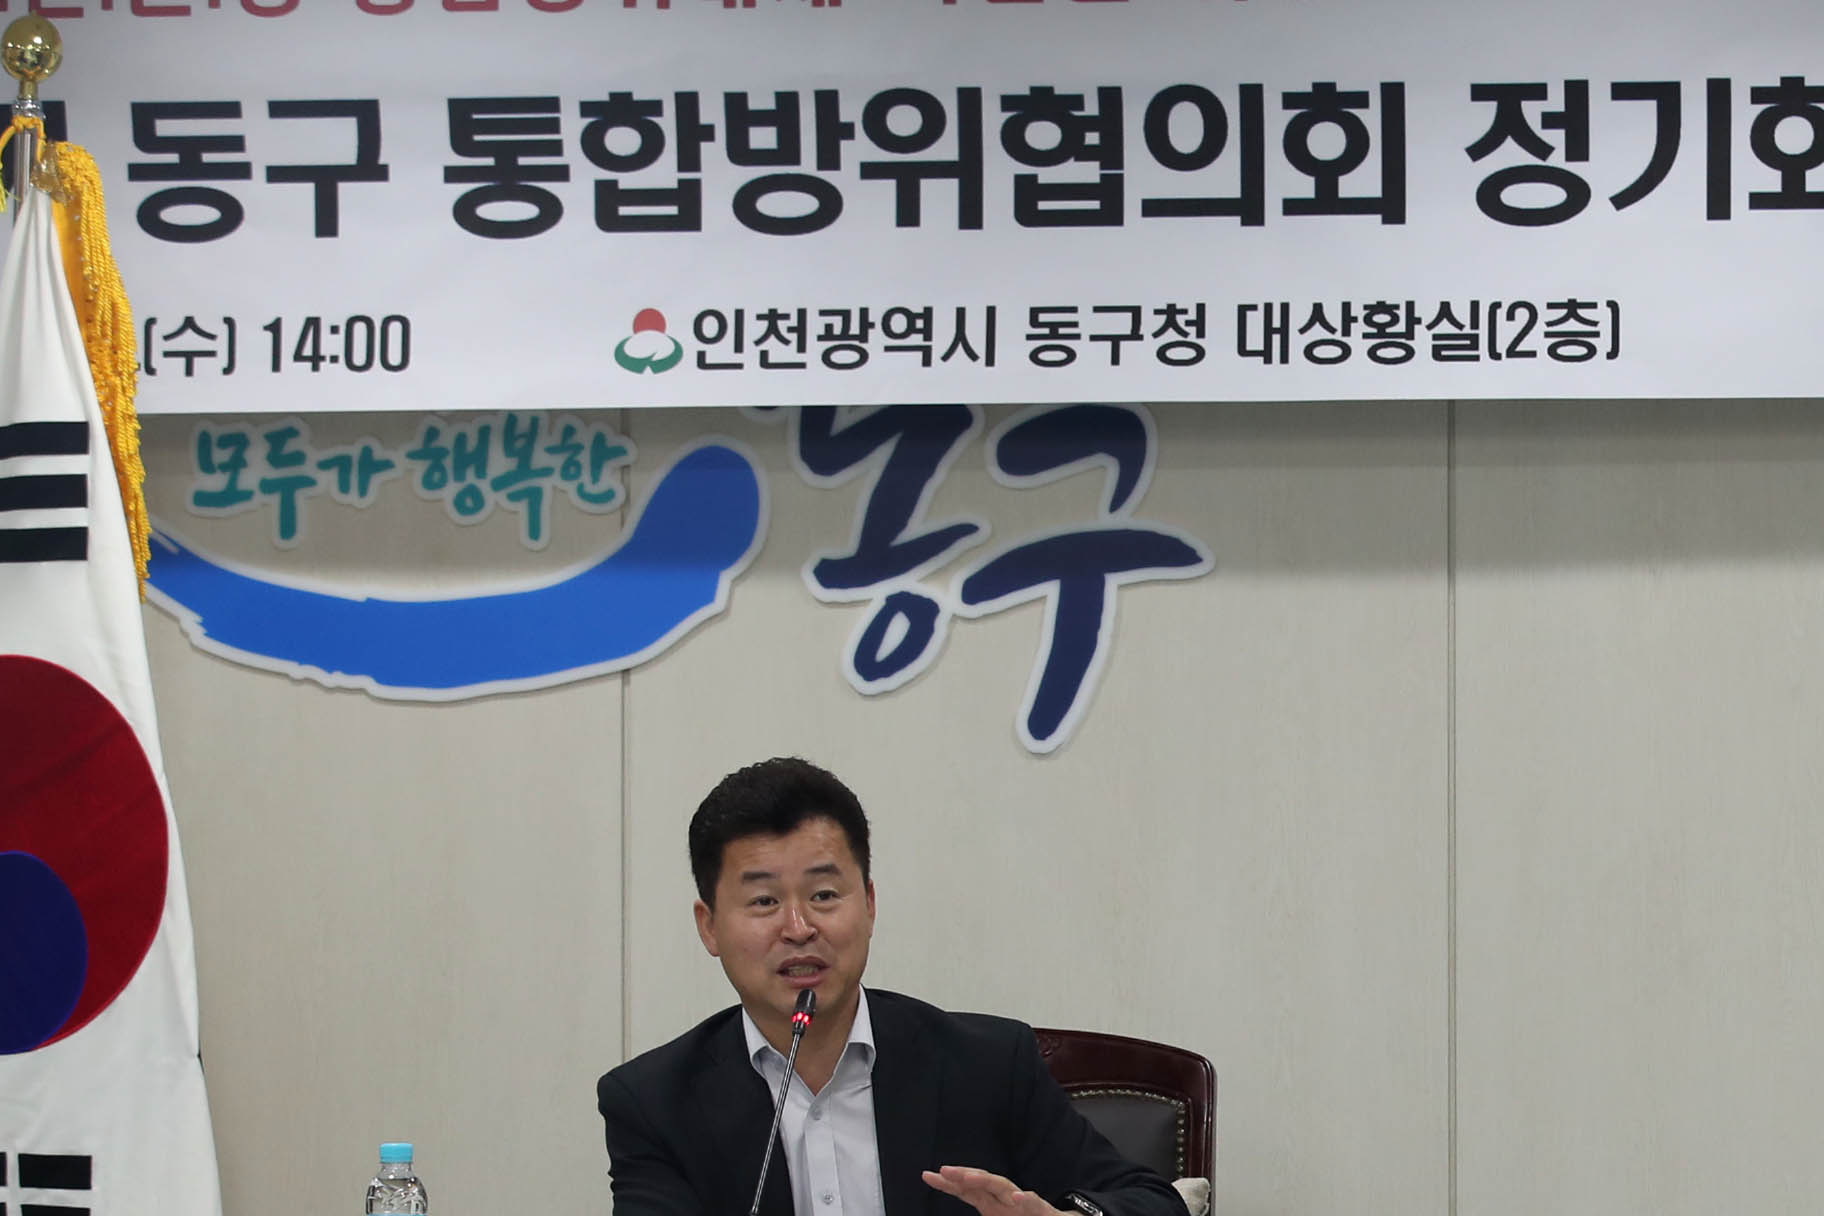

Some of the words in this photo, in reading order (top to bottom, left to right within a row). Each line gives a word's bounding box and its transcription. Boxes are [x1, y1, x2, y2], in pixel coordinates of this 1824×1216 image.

[127, 99, 390, 243] 동구
[443, 82, 1407, 241] 통합방위협의회
[263, 315, 411, 373] 14:00
[693, 306, 996, 371] 인천광역시
[1024, 302, 1207, 367] 동구청
[1236, 298, 1621, 365] 대상황실(2층)
[193, 429, 392, 540] 모두가
[406, 413, 627, 541] 행복한
